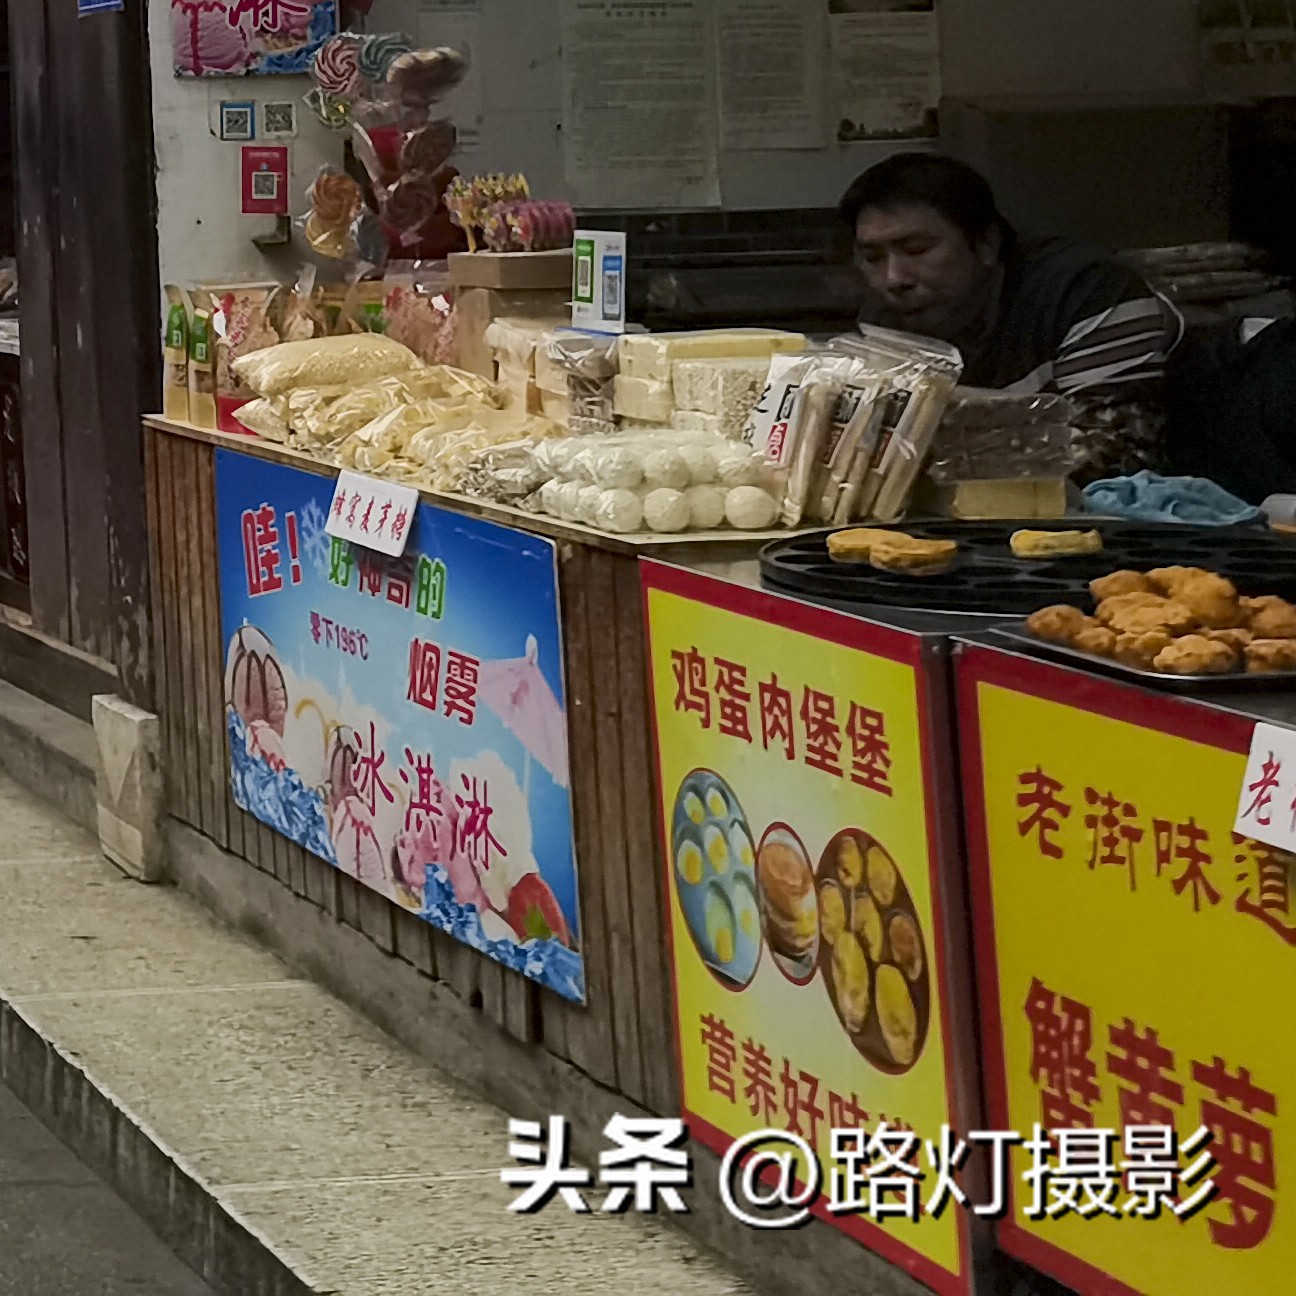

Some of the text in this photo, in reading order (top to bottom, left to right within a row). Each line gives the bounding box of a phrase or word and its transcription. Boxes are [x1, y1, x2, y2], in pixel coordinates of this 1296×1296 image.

[241, 505, 302, 598] 哇！
[408, 637, 481, 726] 烟雾
[670, 645, 894, 798] 鸡蛋肉堡堡
[352, 721, 508, 871] 冰淇淋
[1241, 750, 1296, 832] 老
[1016, 764, 1296, 946] 老街味道
